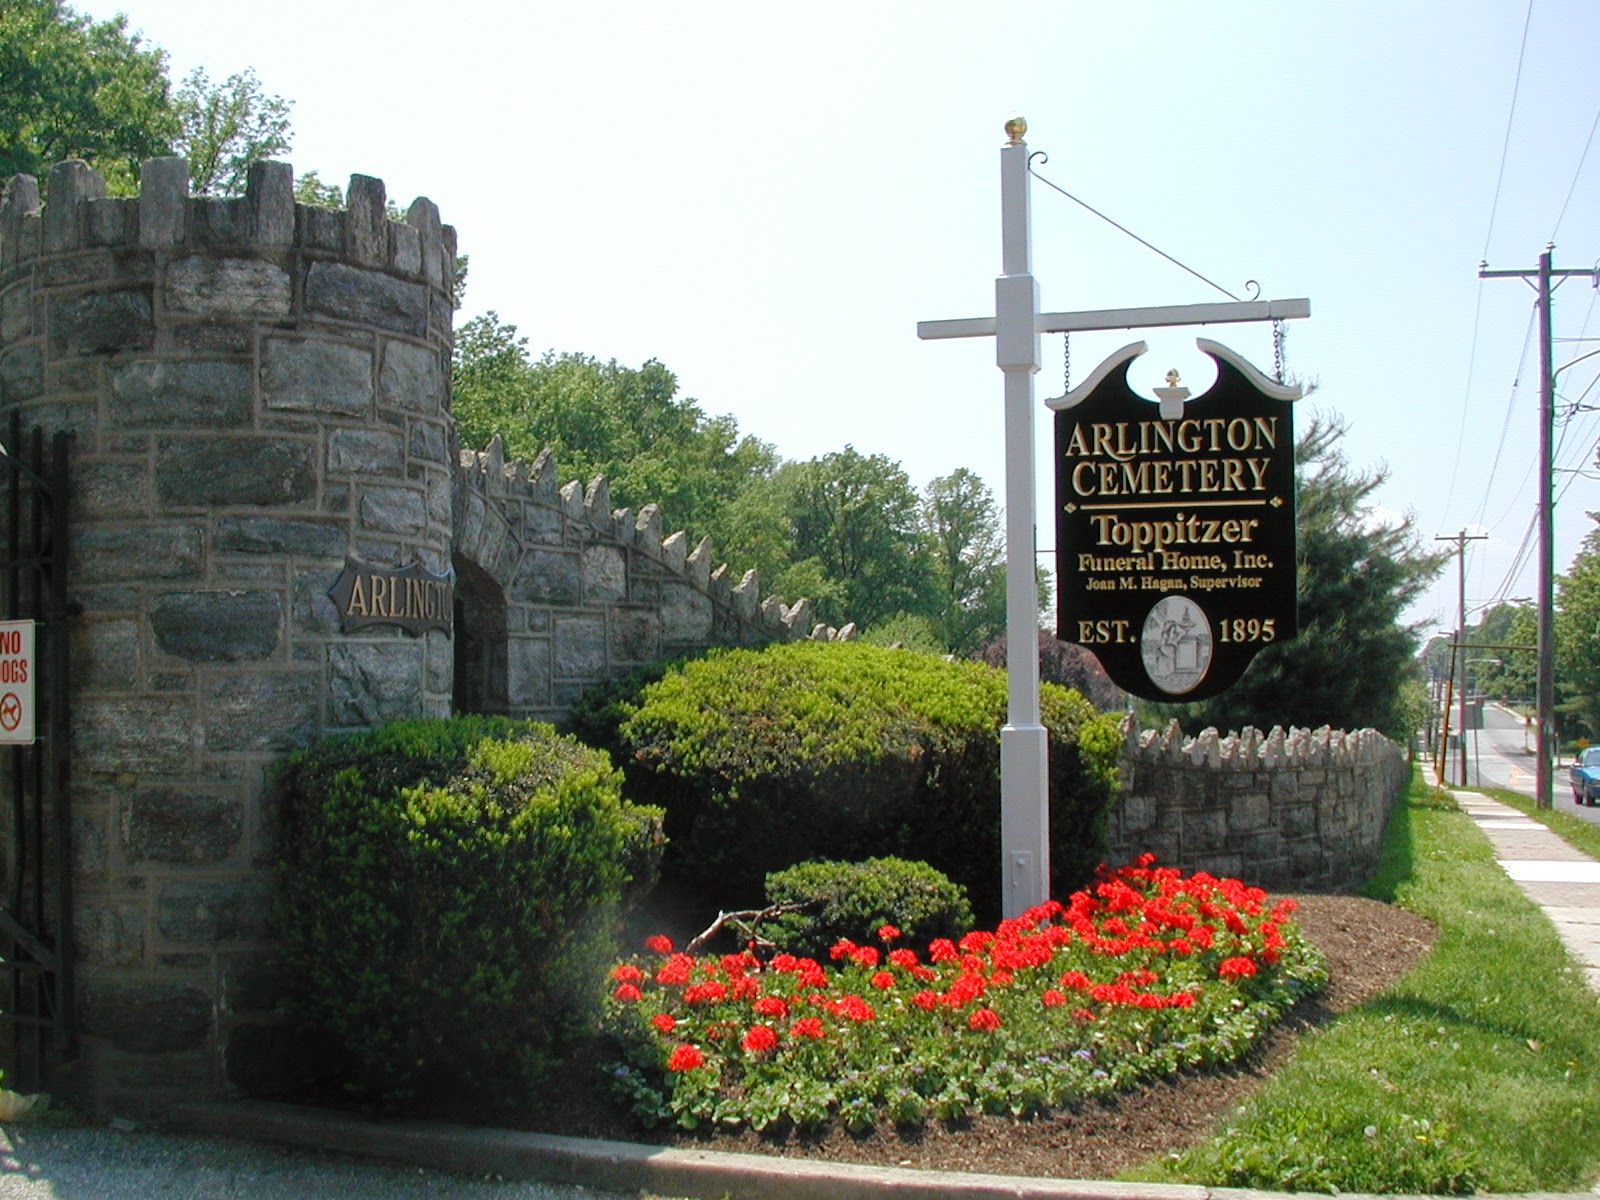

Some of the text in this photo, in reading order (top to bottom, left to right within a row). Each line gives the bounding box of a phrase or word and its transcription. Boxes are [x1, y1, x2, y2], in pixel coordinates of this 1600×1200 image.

[1065, 416, 1277, 461] ARLINGTON
[1072, 457, 1271, 496] CEMETERY
[1090, 512, 1259, 553] Toppitzer
[1078, 550, 1274, 572] Funeral Home, Inc.
[1086, 575, 1263, 592] Joan M. Hagan, Supervisor
[0, 630, 21, 655] NO
[1078, 618, 1276, 643] EST. 1895
[0, 658, 28, 683] OGS
